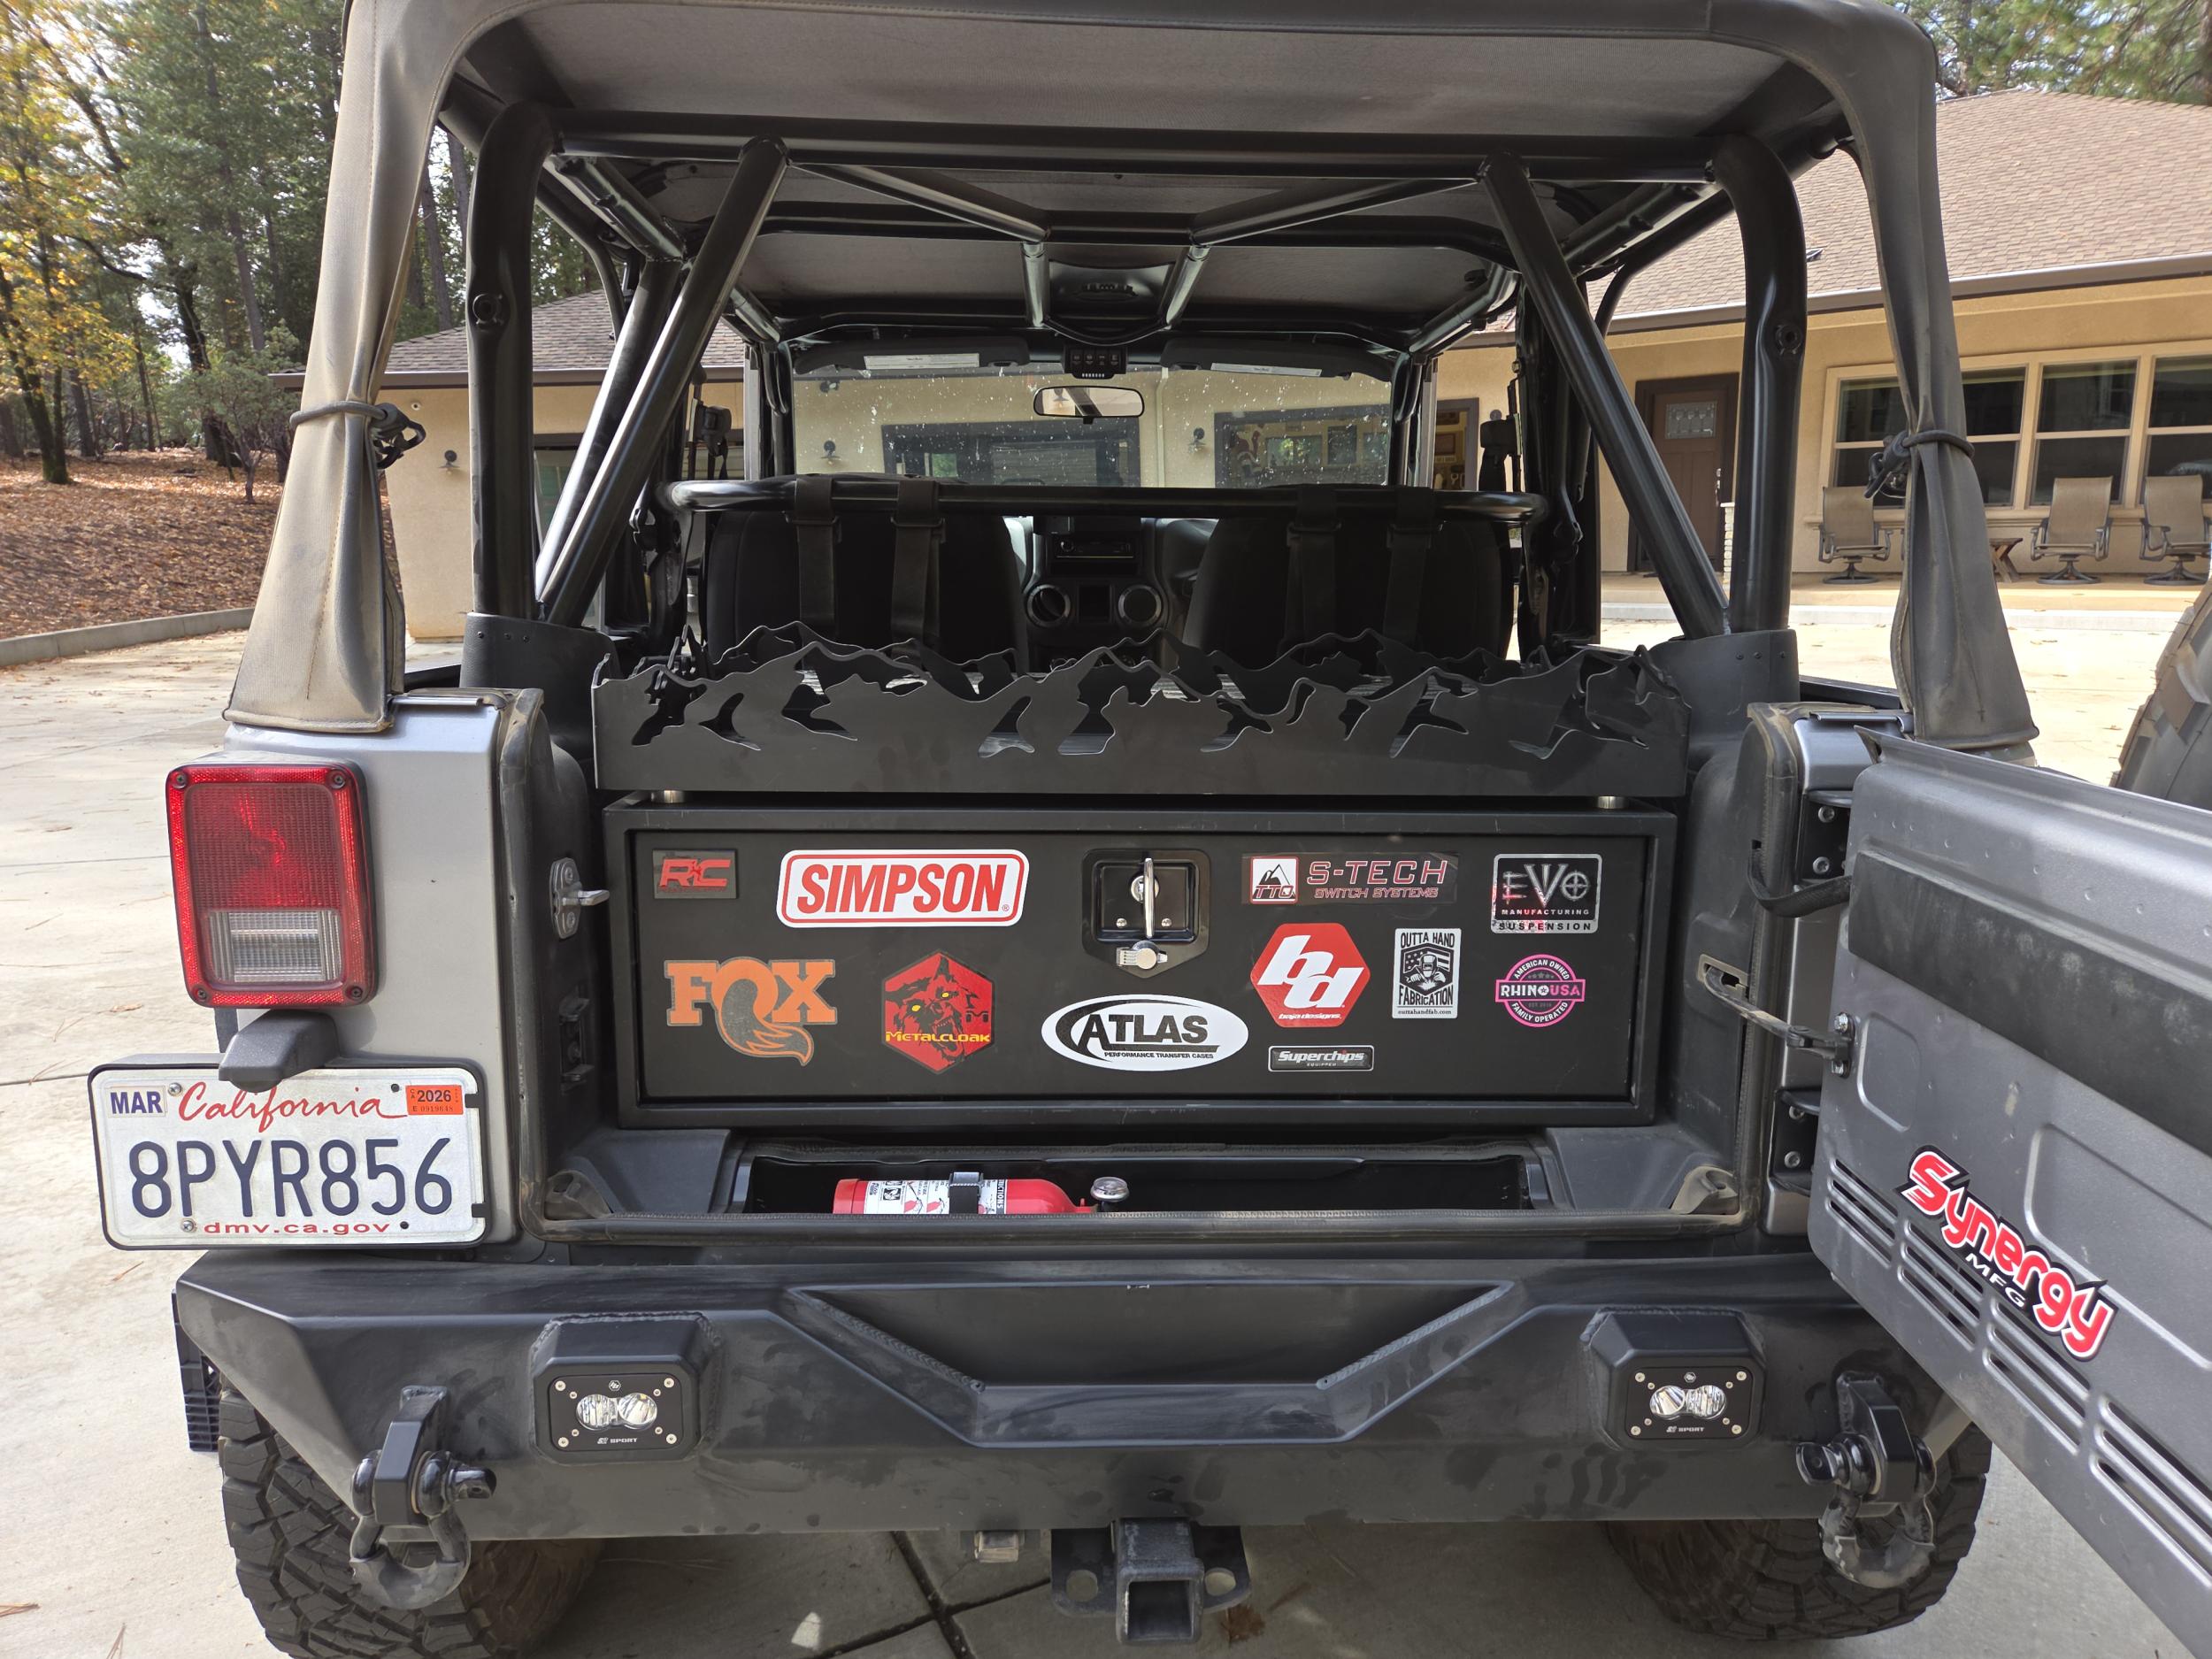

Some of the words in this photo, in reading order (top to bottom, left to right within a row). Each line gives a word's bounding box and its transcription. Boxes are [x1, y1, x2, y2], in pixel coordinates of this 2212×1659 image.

[659, 859, 732, 887] RC
[1307, 861, 1448, 884] S-TECH
[797, 864, 1007, 913] SIMPSON
[1314, 887, 1369, 898] SWITCH
[1372, 887, 1439, 898] SYSTEMS
[1502, 864, 1590, 908] EVO
[1401, 932, 1429, 949] OUTTA
[1432, 933, 1455, 948] HAND
[1514, 959, 1548, 979] AMERICAN
[1549, 961, 1571, 980] OWNED
[1399, 984, 1454, 1005] FABRICATION
[667, 958, 836, 1062] FOX
[1511, 1002, 1533, 1021] FAMILY
[1534, 1002, 1569, 1023] OPERATED
[1077, 1014, 1209, 1050] ATLAS
[1278, 1050, 1364, 1063] Superchips
[111, 1091, 164, 1115] MAR
[178, 1081, 408, 1133] California
[418, 1090, 451, 1102] 2026
[128, 1137, 453, 1218] 8PYR856
[204, 1222, 390, 1235] dmv.ca.gov
[1901, 1151, 2114, 1357] Synergy
[1965, 1253, 2025, 1308] MFG
